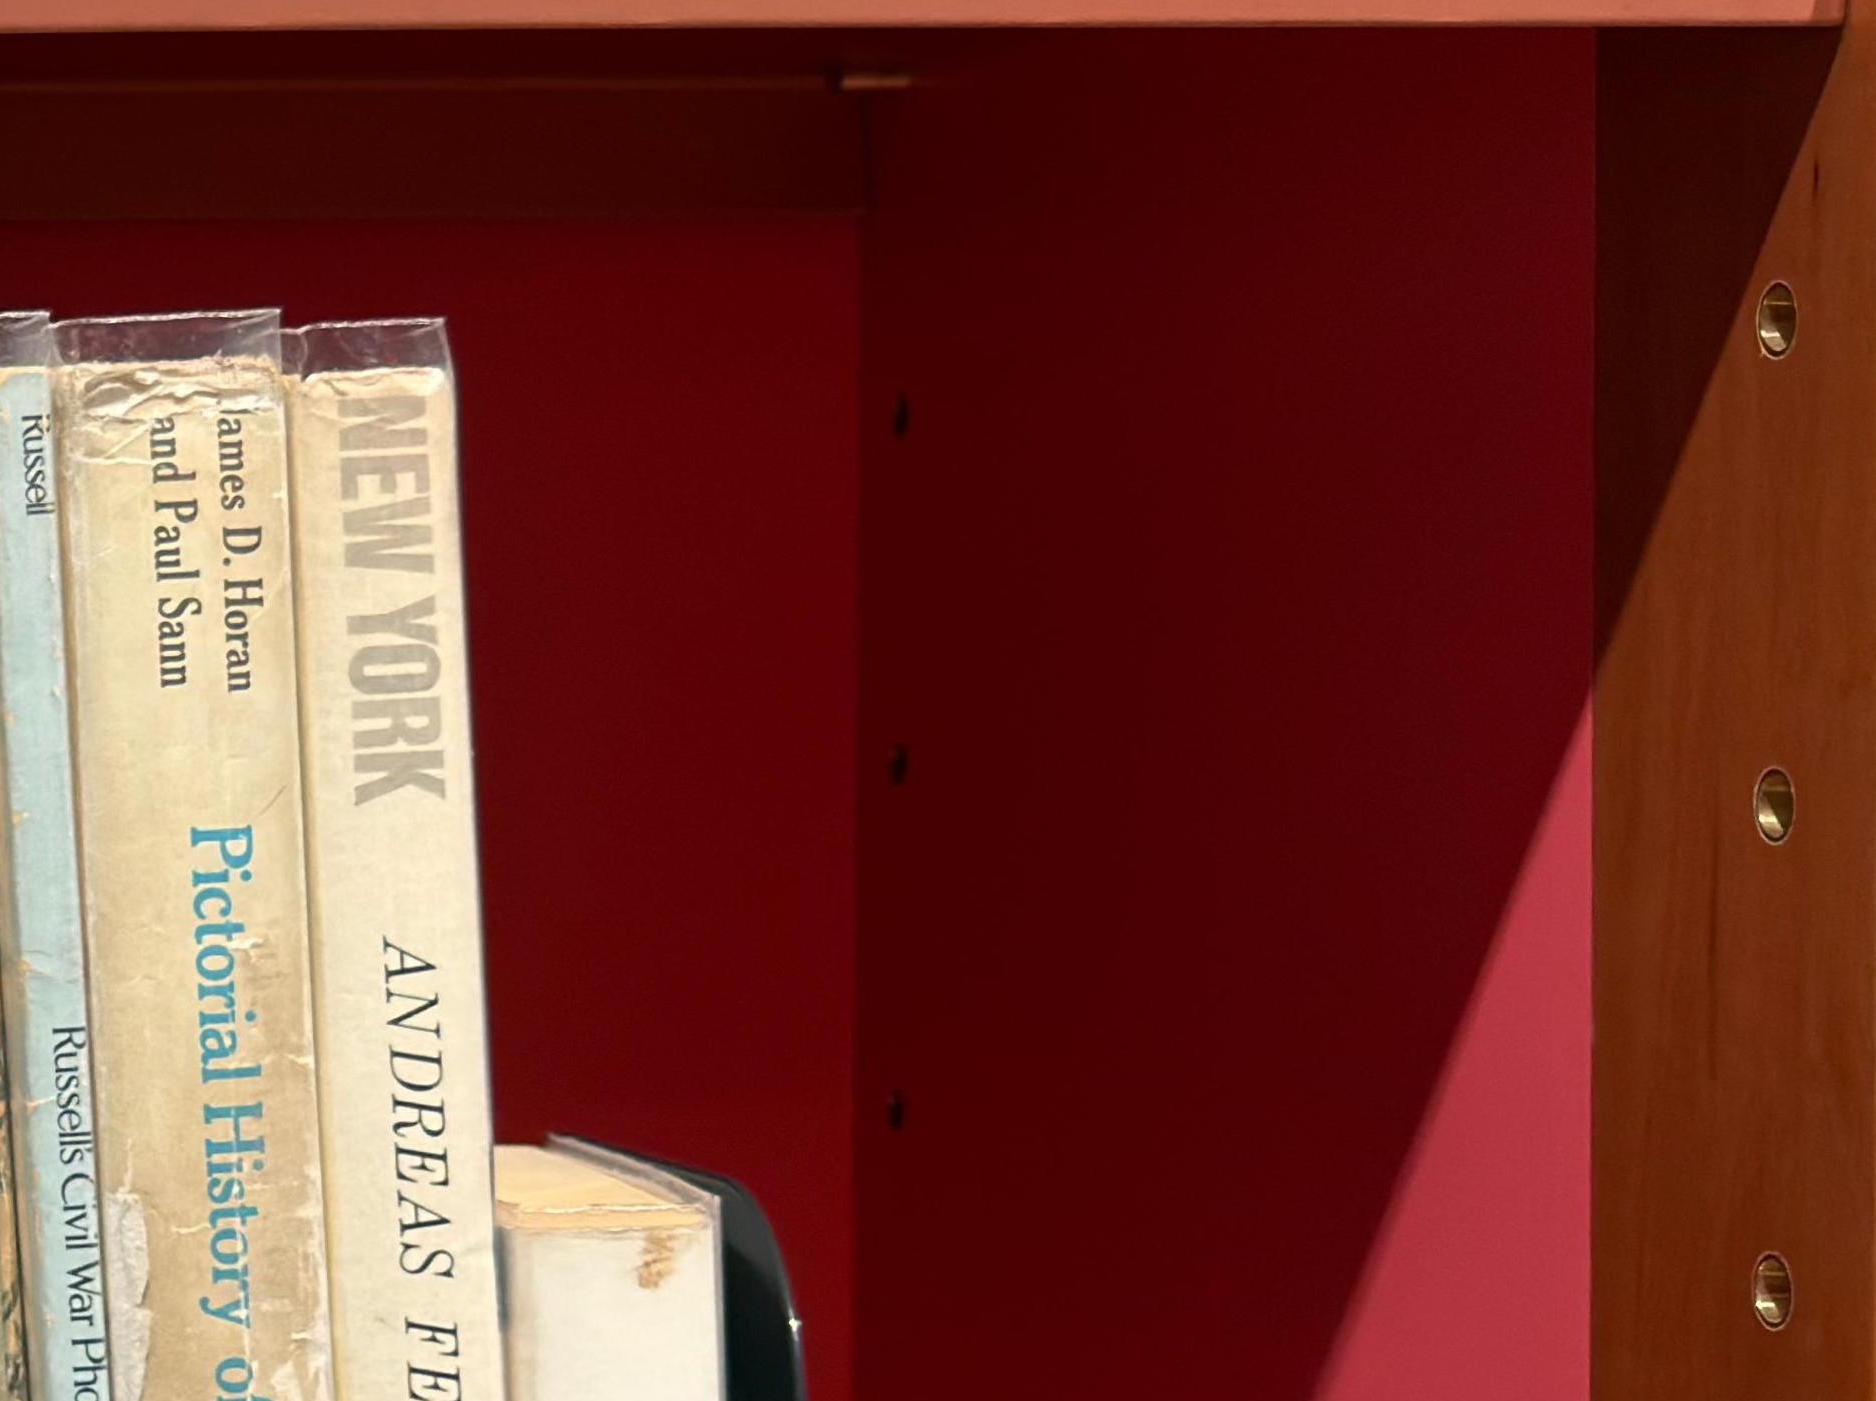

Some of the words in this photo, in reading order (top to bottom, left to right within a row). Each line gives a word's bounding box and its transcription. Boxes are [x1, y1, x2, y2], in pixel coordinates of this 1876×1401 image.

[150, 417, 196, 484] and
[337, 395, 435, 573] NEW
[154, 496, 200, 582] Paul
[221, 524, 262, 567] D.
[159, 596, 201, 689] Sann
[223, 576, 264, 693] Horan
[346, 595, 447, 806] YORK
[190, 824, 262, 1084] Pictorial
[381, 935, 455, 1282] ANDREAS
[59, 1166, 99, 1250] Civil
[199, 1103, 264, 1328] History
[65, 1257, 100, 1326] War
